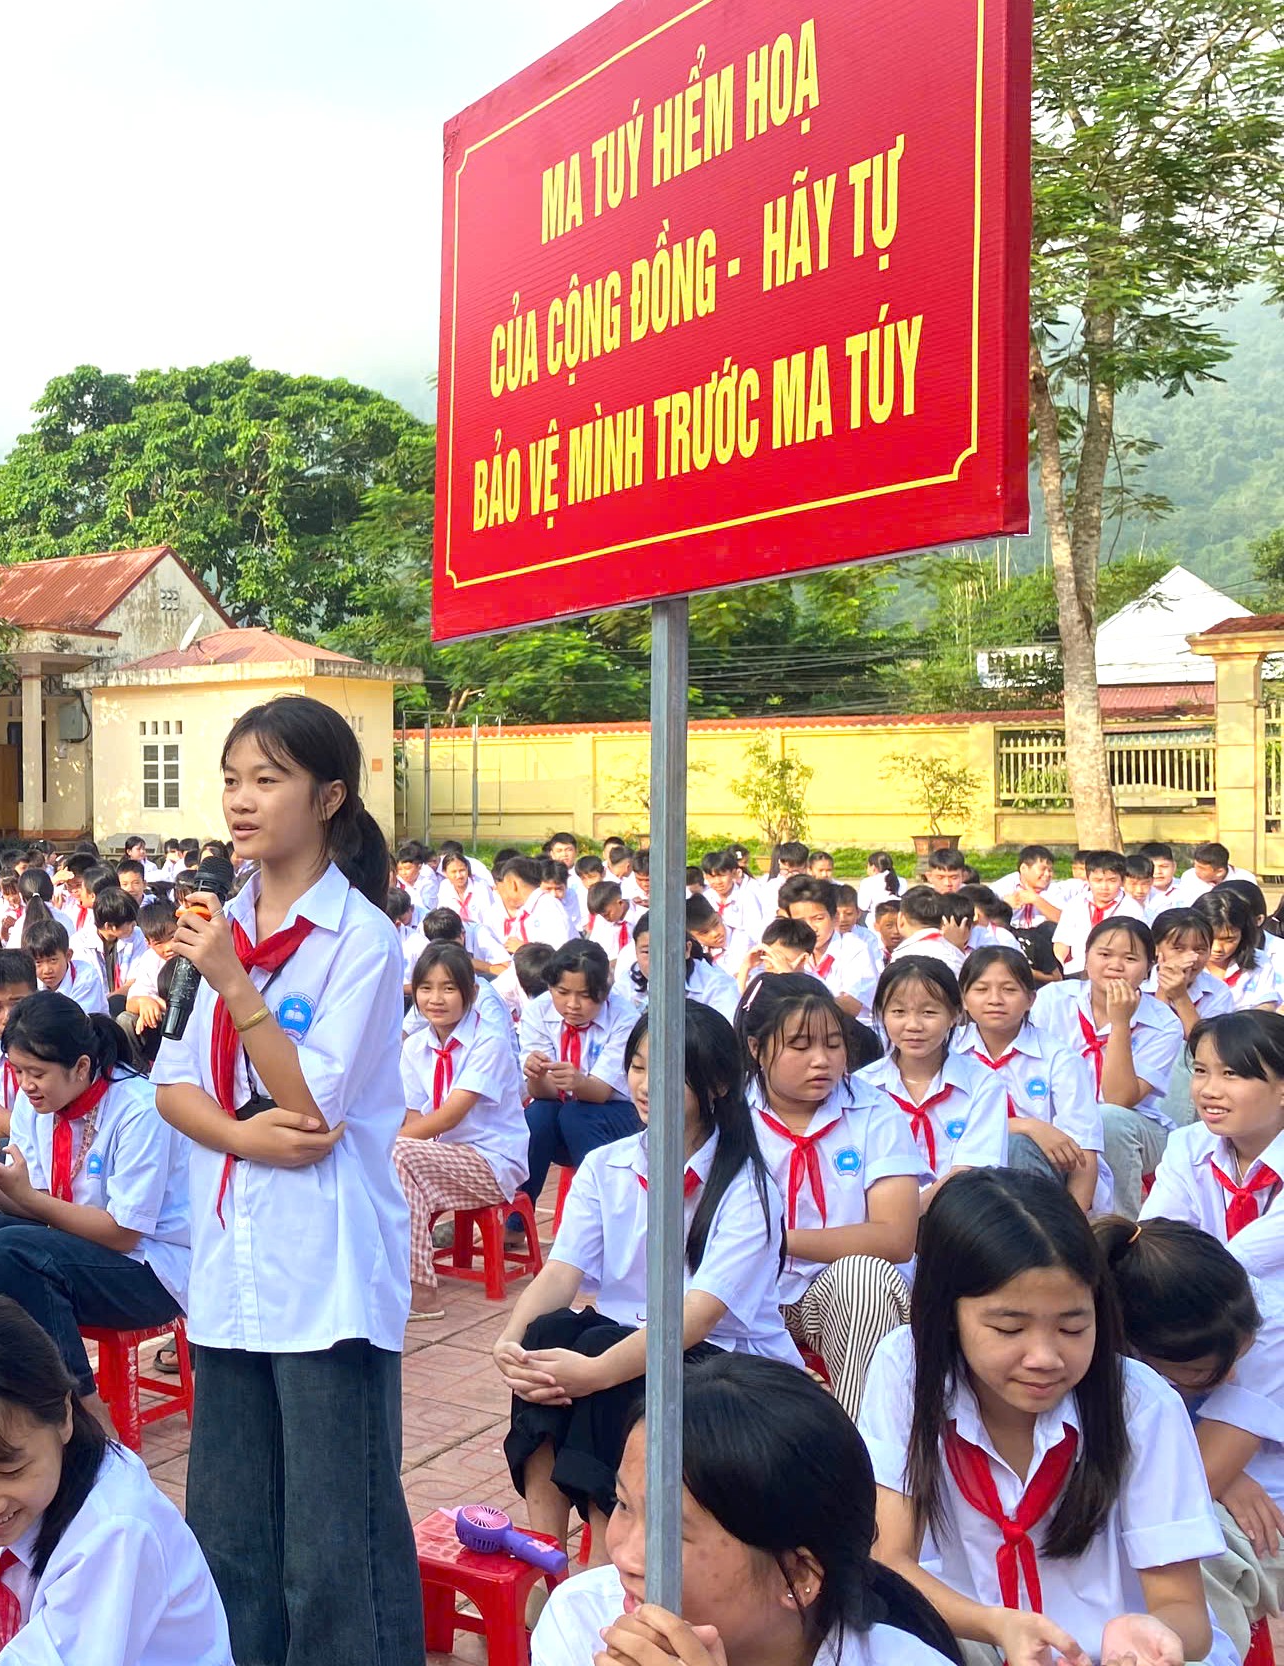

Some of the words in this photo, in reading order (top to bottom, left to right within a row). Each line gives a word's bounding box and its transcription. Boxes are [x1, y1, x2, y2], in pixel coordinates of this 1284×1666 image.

[541, 152, 584, 246] MA
[591, 98, 644, 218] TUÝ
[652, 43, 735, 187] HIỂM
[745, 18, 820, 142] HOẠ
[490, 291, 539, 398] CỦA
[546, 273, 621, 386] CỘNG
[630, 218, 716, 342] ĐỒNG
[763, 166, 837, 292] HÃY
[848, 134, 905, 271] TỰ
[472, 428, 521, 532] BẢO
[528, 418, 560, 530] VỆ
[567, 403, 644, 505] MÌNH
[653, 357, 760, 480] TRƯỚC
[772, 345, 833, 449] MA
[845, 303, 923, 430] TÚY
